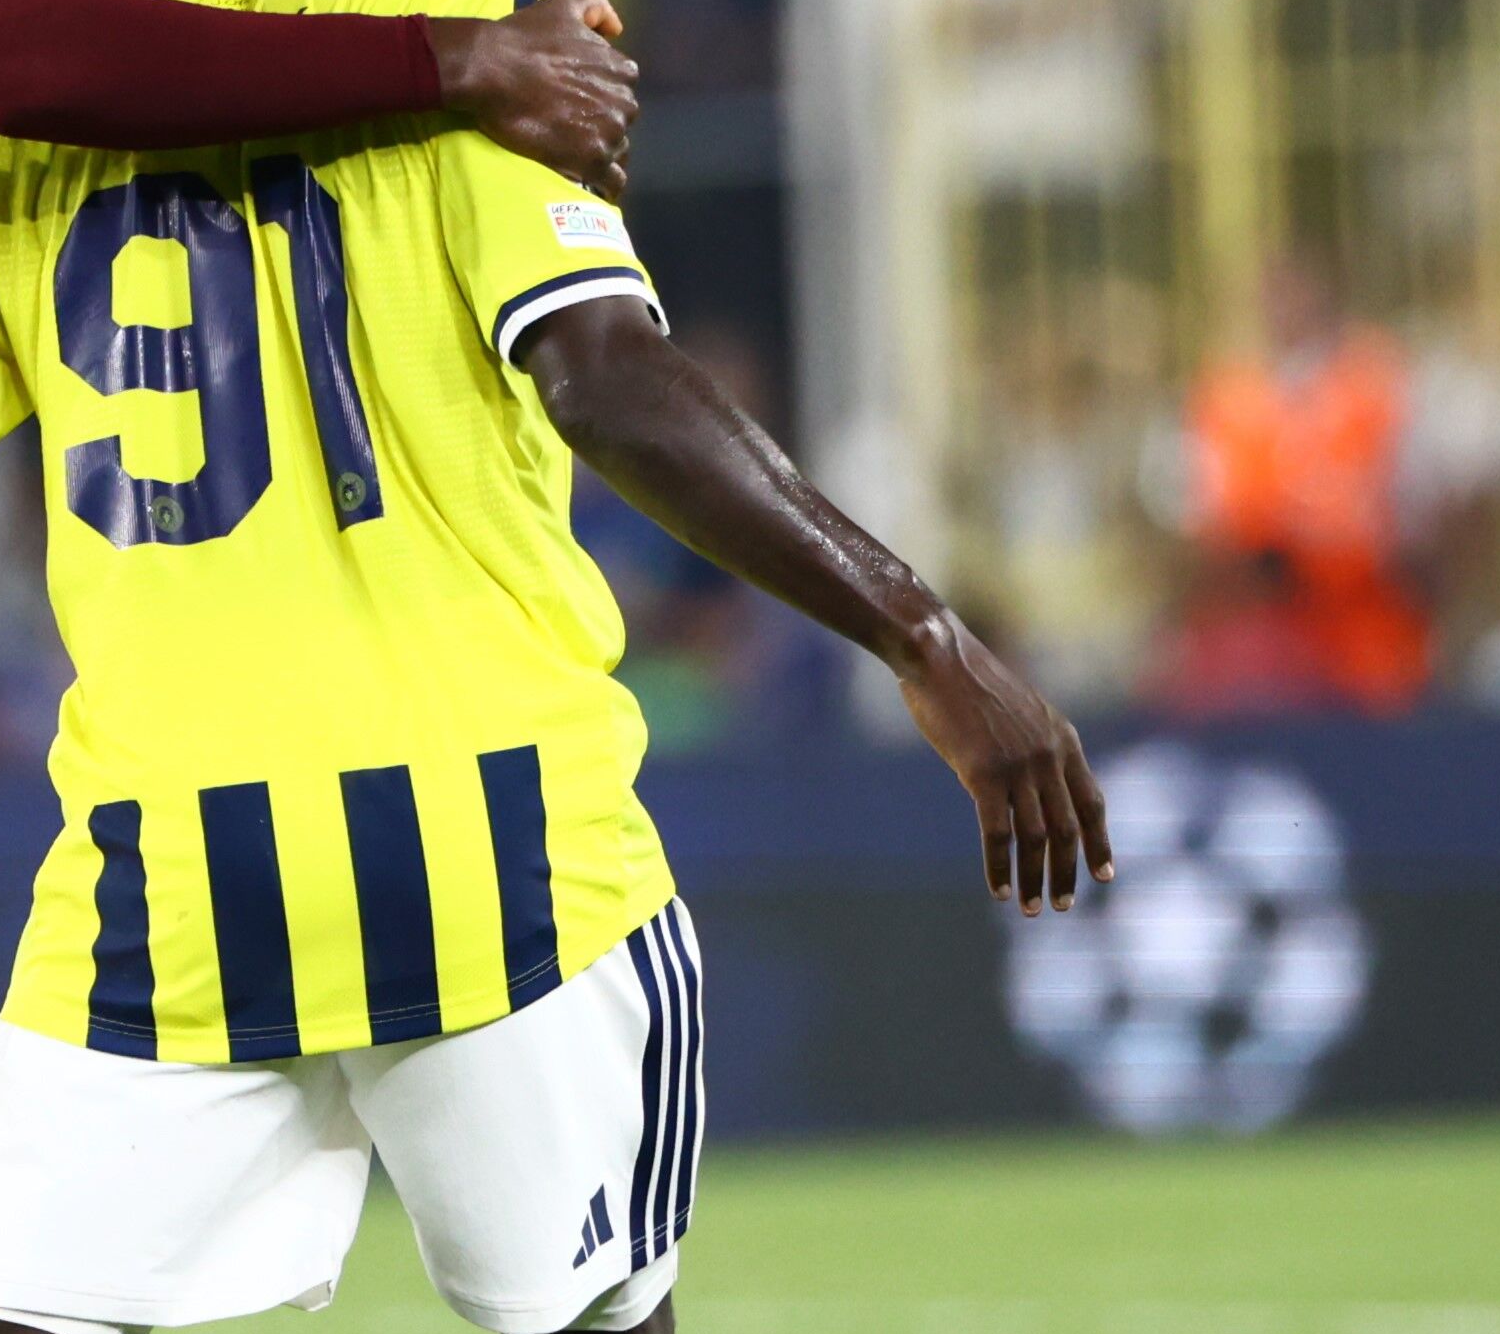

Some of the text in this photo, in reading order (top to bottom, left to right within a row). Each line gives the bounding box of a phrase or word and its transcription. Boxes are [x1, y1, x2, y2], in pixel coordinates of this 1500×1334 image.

[551, 204, 581, 214] UEFA
[554, 215, 612, 234] FOUN
[54, 153, 384, 551] 91
